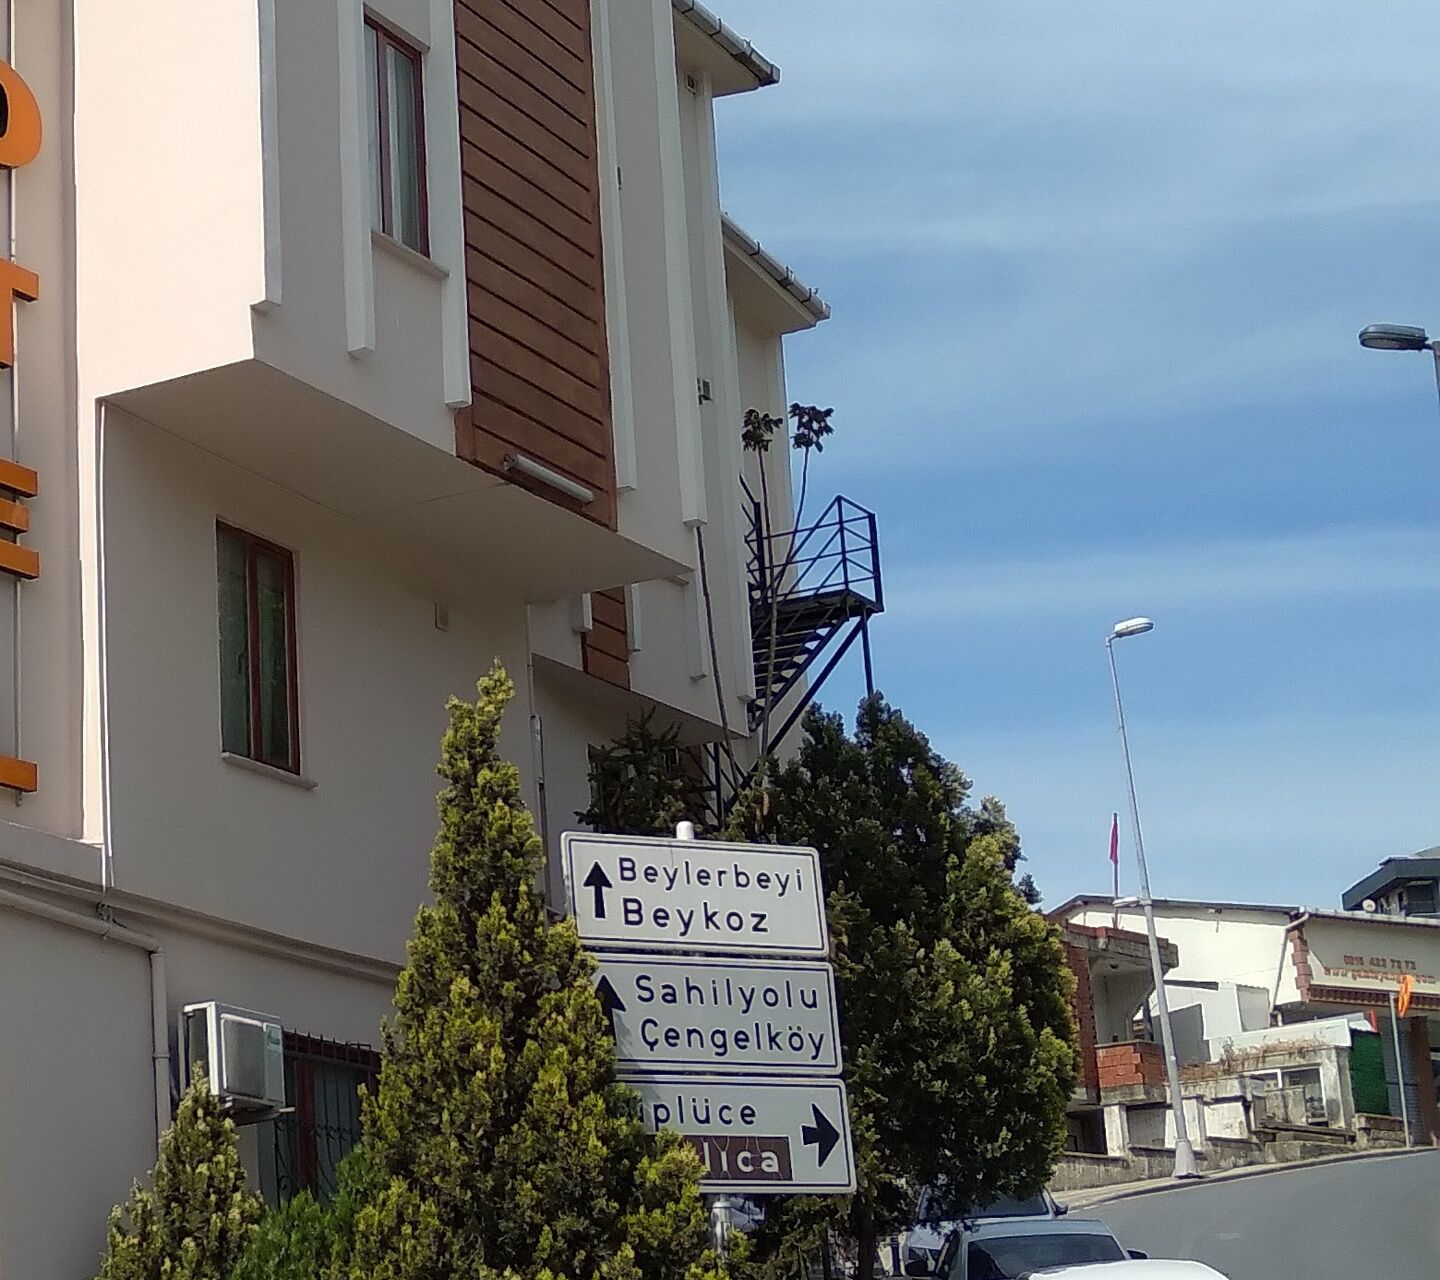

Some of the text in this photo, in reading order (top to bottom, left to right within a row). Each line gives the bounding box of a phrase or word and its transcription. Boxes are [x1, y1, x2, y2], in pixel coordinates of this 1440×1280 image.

[618, 856, 803, 898] Beylerbeyi
[622, 897, 769, 936] Beykoz
[635, 974, 819, 1014] Sahilyolu
[640, 1018, 825, 1060] Çengelköy
[639, 1094, 757, 1132] plüce
[702, 1140, 780, 1174] lıca
